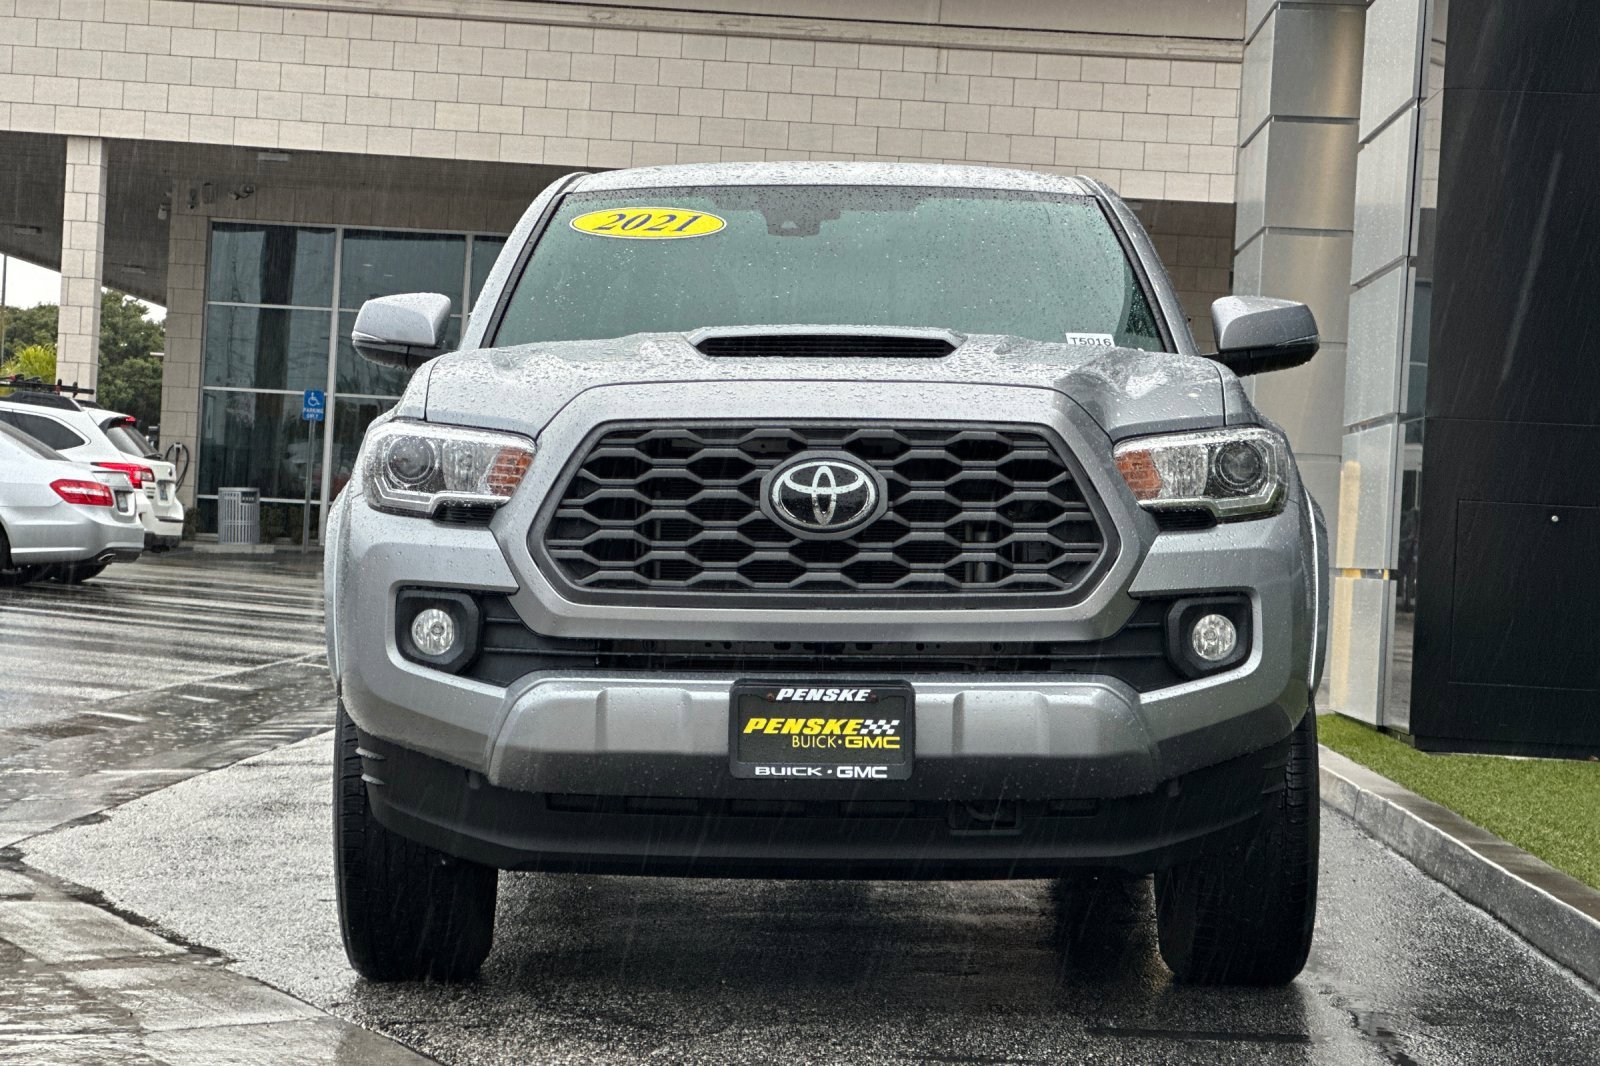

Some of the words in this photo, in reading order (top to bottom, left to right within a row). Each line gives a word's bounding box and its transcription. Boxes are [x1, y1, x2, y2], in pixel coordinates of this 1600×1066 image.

[592, 213, 702, 232] 2021
[1070, 337, 1112, 347] T5016
[775, 688, 871, 702] PENSKE
[743, 717, 864, 735] PENSKE
[792, 735, 837, 749] BUICK
[844, 736, 900, 749] GMC
[755, 766, 822, 776] BUICK
[836, 766, 888, 778] GMC
